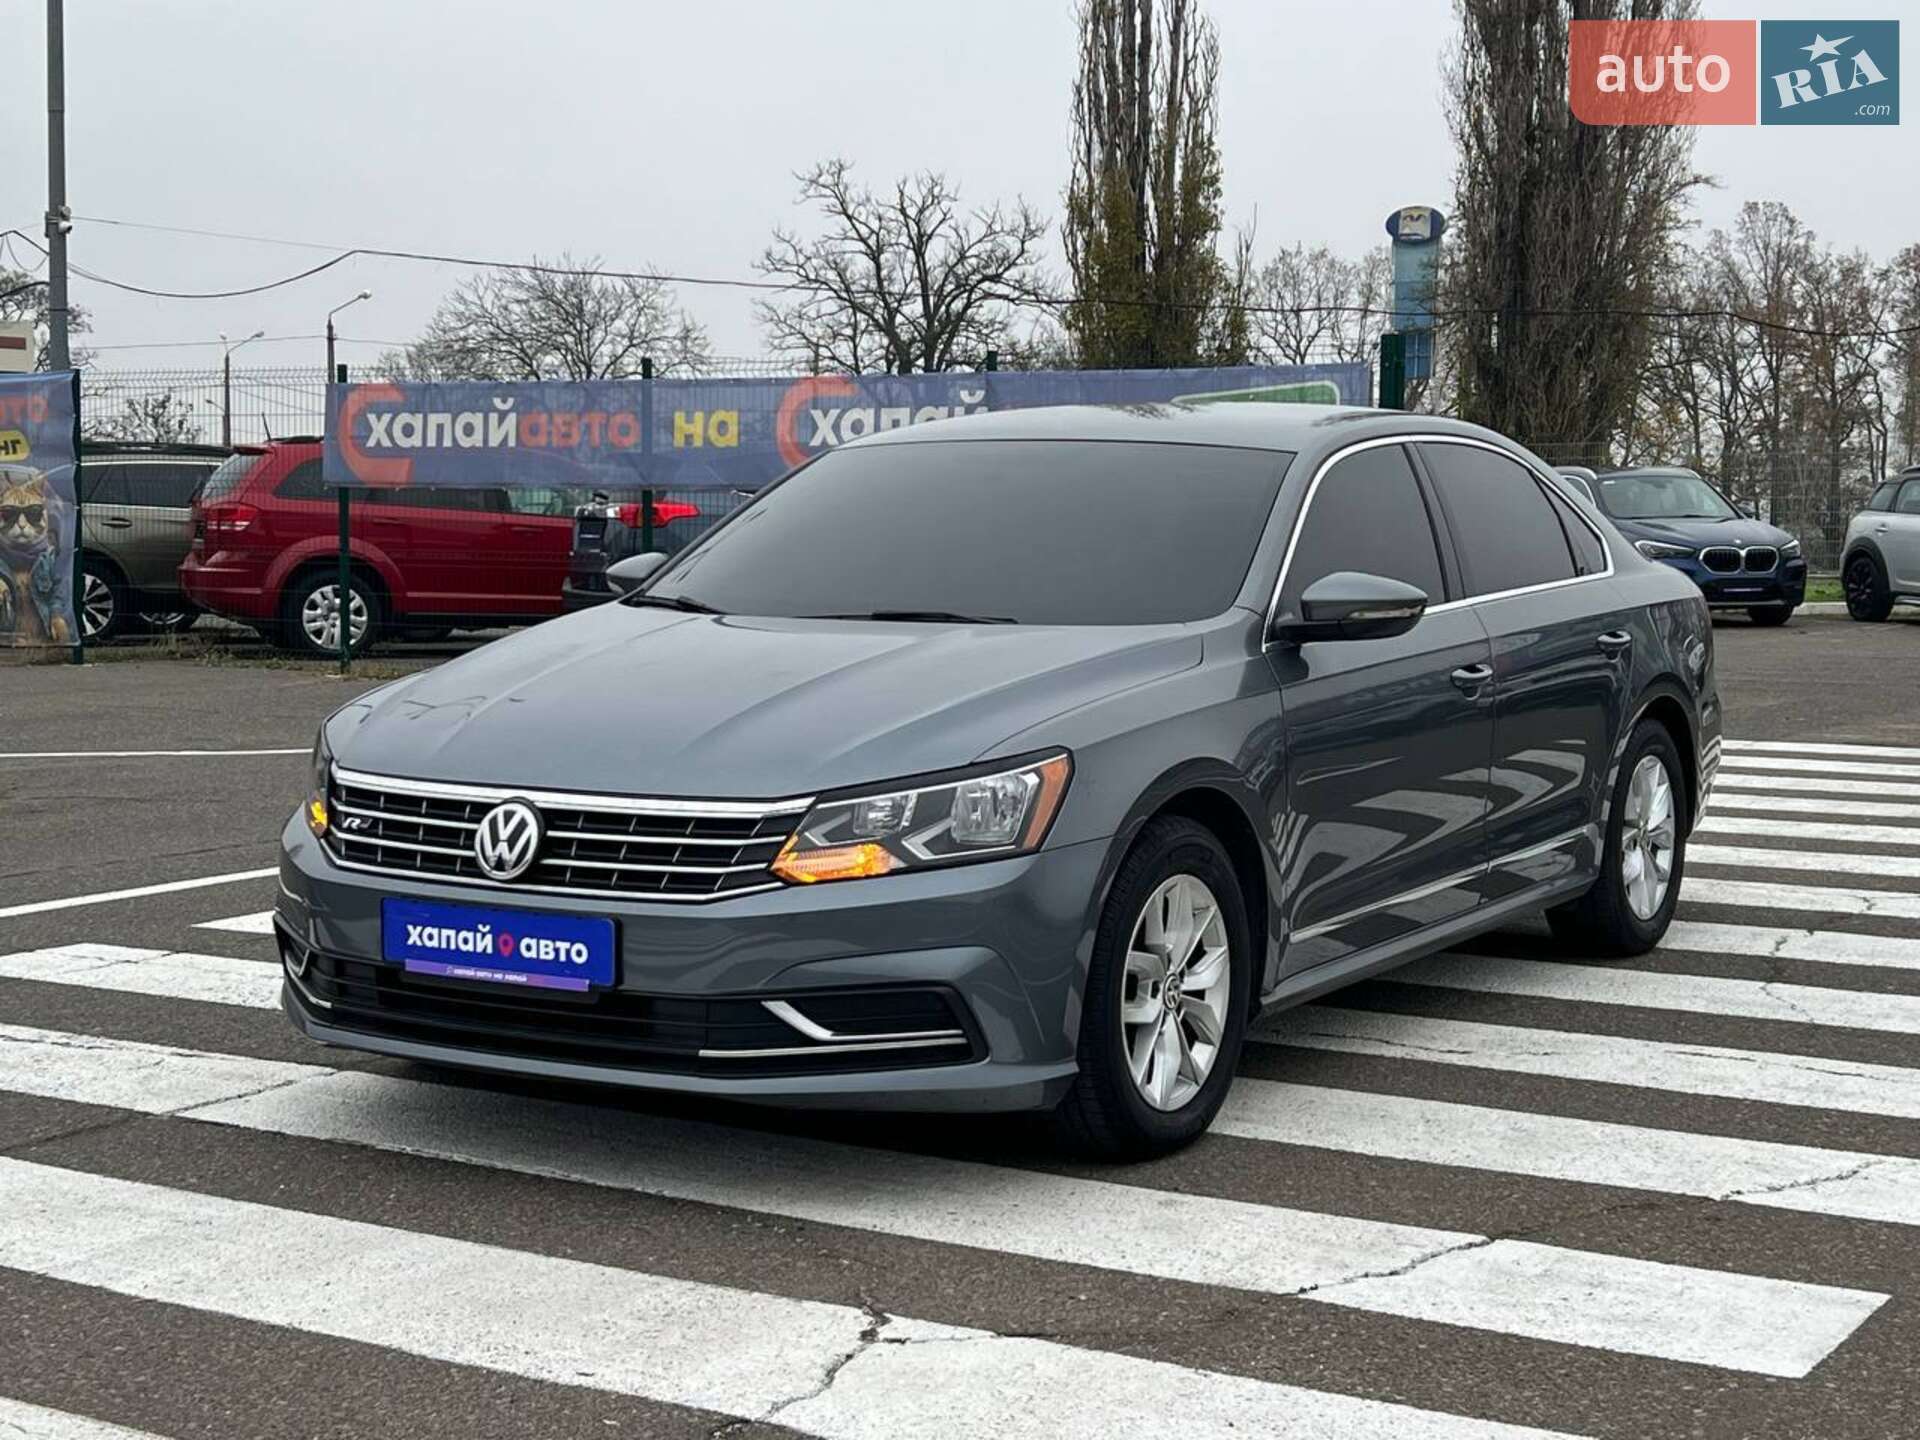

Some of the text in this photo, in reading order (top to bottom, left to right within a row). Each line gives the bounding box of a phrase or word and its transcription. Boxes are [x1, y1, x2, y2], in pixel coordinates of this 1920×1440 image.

[672, 409, 739, 447] на
[406, 924, 589, 965] хапай авто
